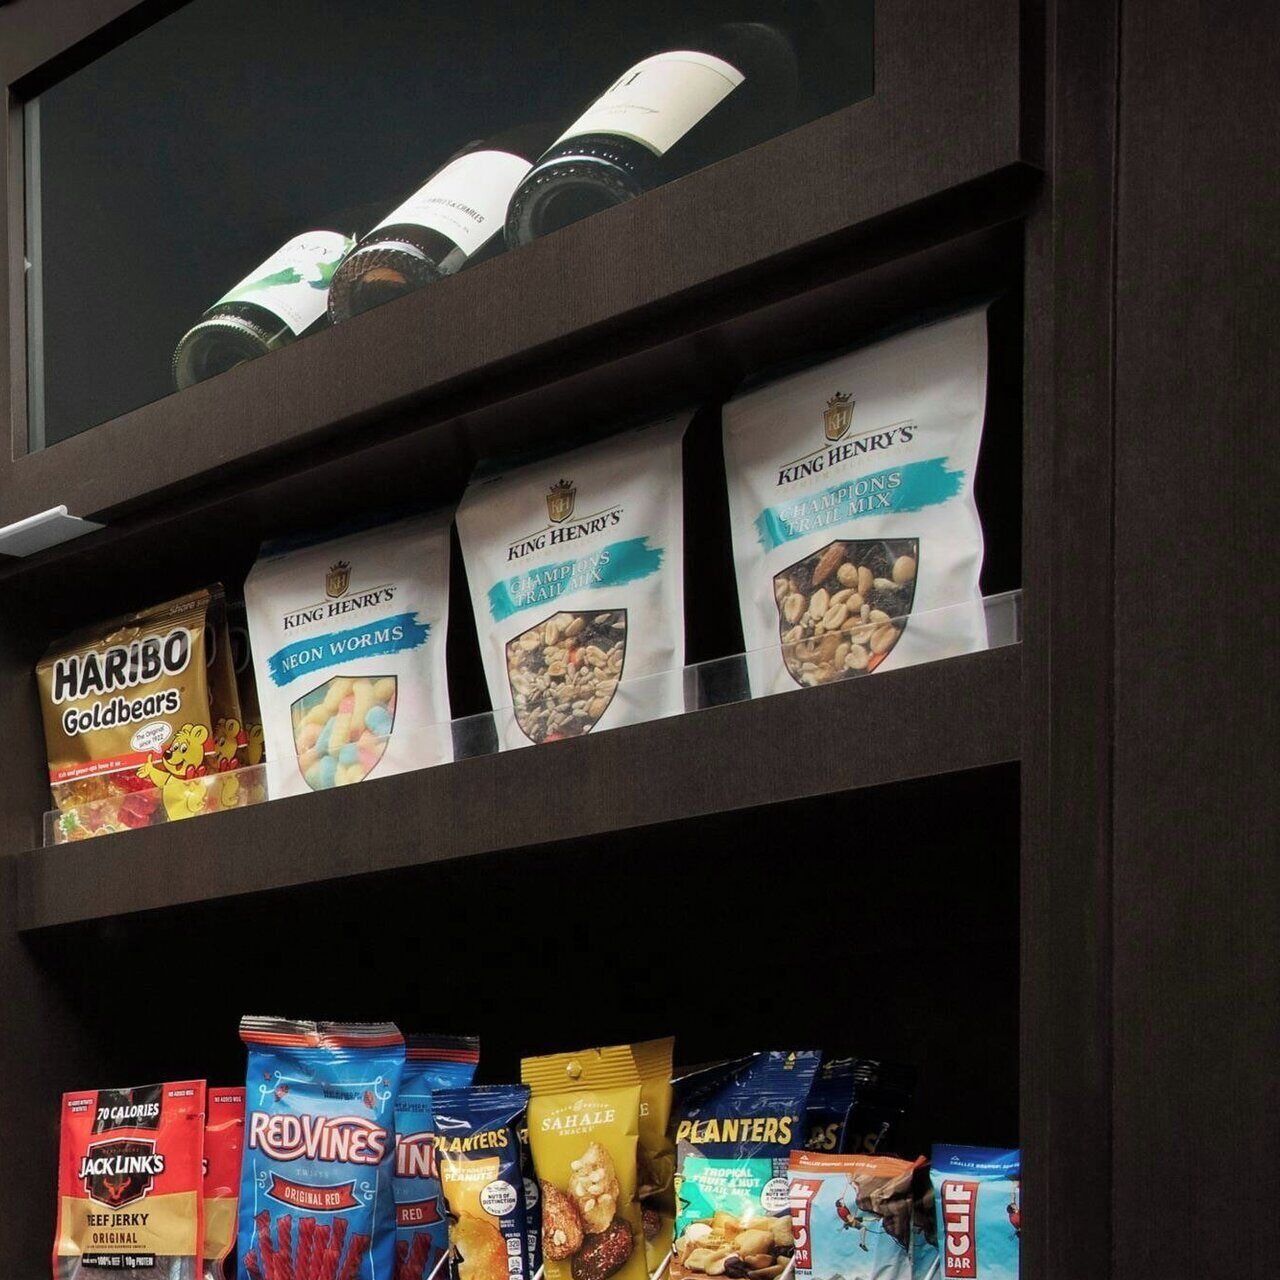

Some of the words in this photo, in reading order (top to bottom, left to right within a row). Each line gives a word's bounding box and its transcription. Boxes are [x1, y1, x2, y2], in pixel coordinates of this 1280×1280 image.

[776, 455, 824, 487] KING
[828, 425, 914, 467] HENRY'S
[780, 471, 901, 522] CHAMPIONS
[785, 509, 842, 537] TRAIL
[847, 491, 892, 518] MIX
[507, 534, 545, 562] KING
[550, 510, 621, 545] HENRY'S
[510, 551, 611, 595] CHAMPIONS
[515, 584, 565, 606] TRAIL
[569, 569, 605, 591] MIX
[283, 609, 323, 630] KING
[326, 588, 395, 619] HENRY'S
[281, 646, 323, 673] NEON
[330, 625, 404, 656] WORMS
[53, 627, 192, 703] HARIBO
[63, 690, 179, 735] Goldbears
[97, 1106, 109, 1120] 70
[110, 1103, 160, 1119] CALORIES
[541, 1109, 615, 1132] SAHALE
[434, 1129, 507, 1152] PLANTERS
[676, 1116, 793, 1145] PLANTERS
[79, 1155, 114, 1178] JACK
[116, 1154, 164, 1175] LINK'S
[703, 1167, 752, 1178] TROPICAL
[694, 1174, 727, 1186] FRUIT
[737, 1177, 760, 1188] NUT
[699, 1183, 730, 1195] TRAIL
[732, 1185, 751, 1196] MIX
[285, 1187, 323, 1205] ORIGINAL
[324, 1192, 341, 1205] RED
[87, 1214, 110, 1226] BEEF
[111, 1213, 149, 1226] JERKY
[402, 1208, 423, 1221] RED
[946, 1183, 972, 1256] CLIF
[93, 1232, 137, 1243] ORIGINAL
[947, 1257, 971, 1269] BAR
